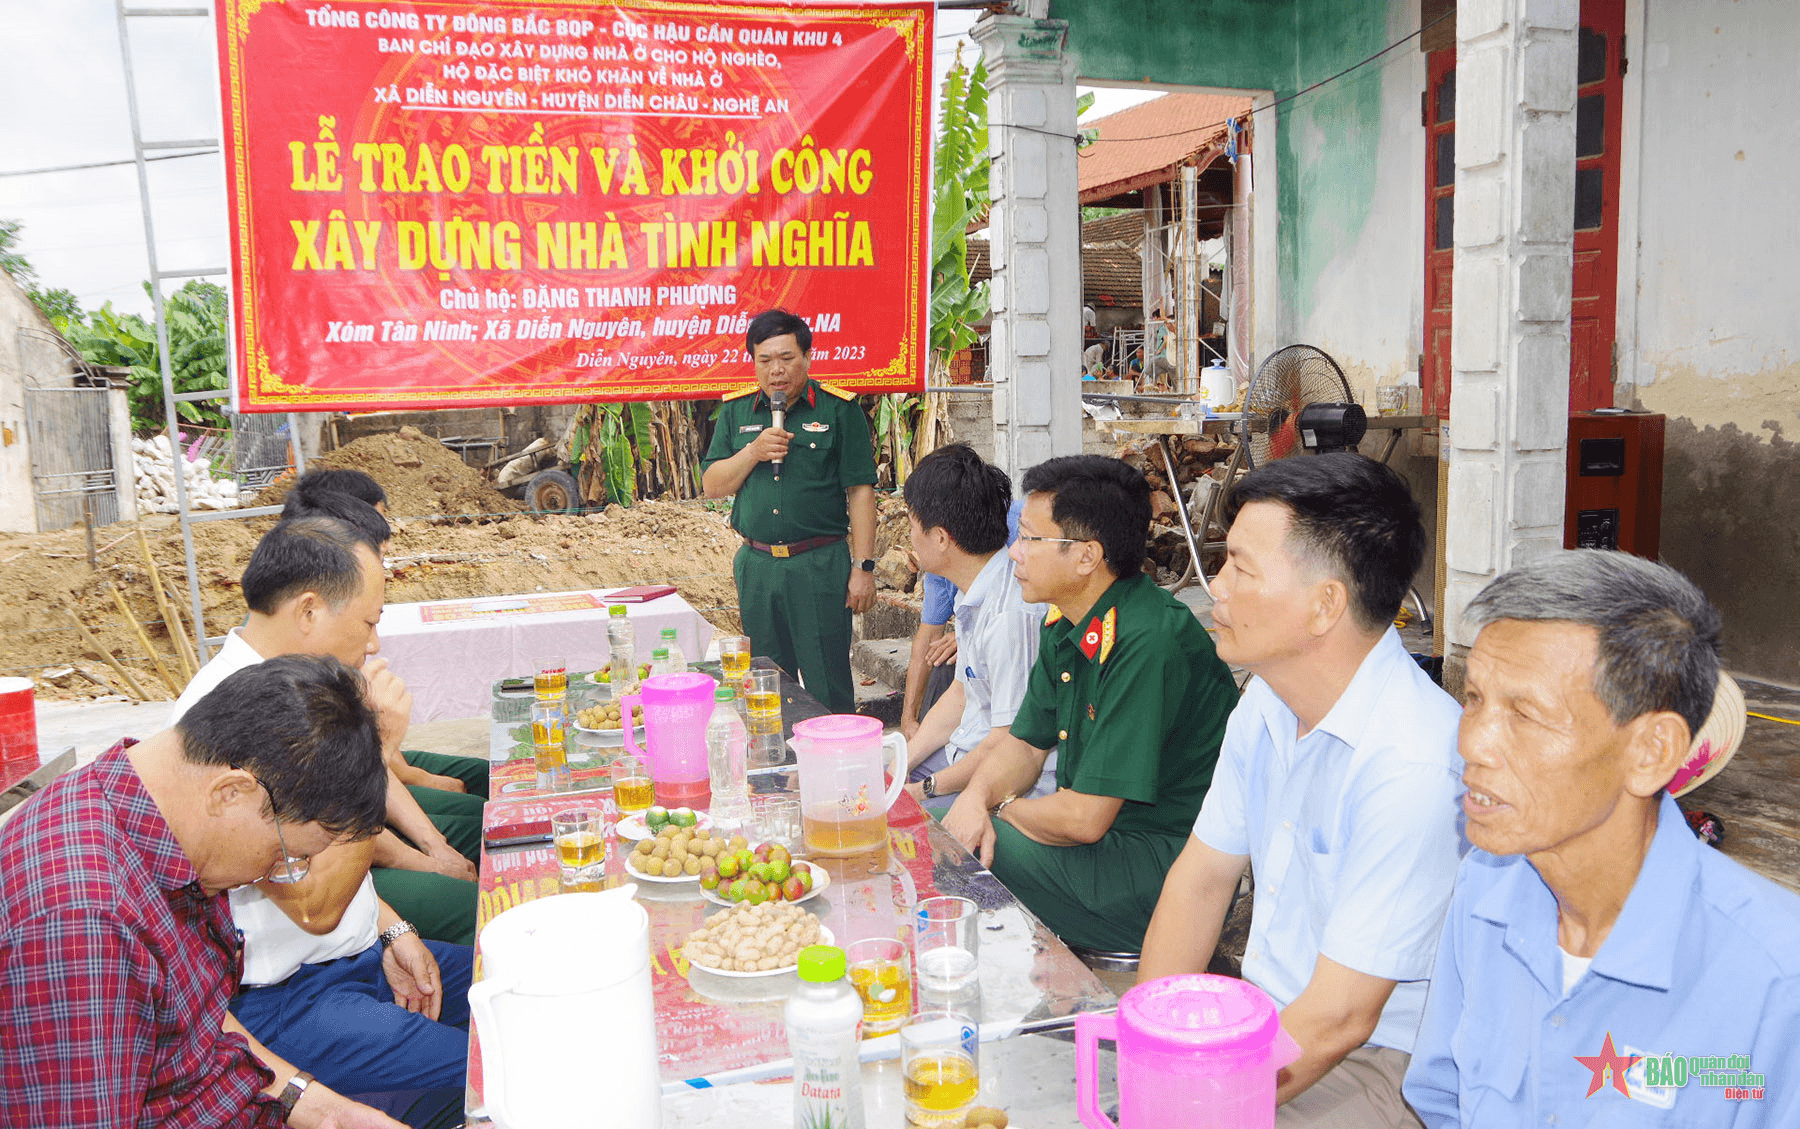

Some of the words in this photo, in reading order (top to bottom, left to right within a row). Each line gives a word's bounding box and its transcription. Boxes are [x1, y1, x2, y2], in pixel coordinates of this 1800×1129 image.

[305, 4, 360, 28] TỔNG
[365, 9, 420, 30] CÔNG
[424, 14, 447, 31] TY
[453, 13, 506, 34] ĐÔNG
[512, 14, 551, 36] BẮC
[557, 20, 593, 37] BQP
[612, 21, 648, 41] CỤC
[653, 23, 690, 43] HẬU
[738, 27, 787, 46] QUÂN
[792, 31, 827, 46] KHU
[832, 32, 843, 46] 4
[378, 38, 414, 53] BAN
[419, 36, 451, 55] CHỈ
[455, 41, 495, 60] ĐẠO
[500, 40, 534, 58] XÂY
[540, 44, 588, 62] DỰNG
[593, 43, 629, 61] NHÀ
[634, 43, 647, 61] Ở
[651, 48, 688, 64] CHO
[692, 48, 717, 68] HỘ
[722, 50, 781, 69] NGHÈO,
[443, 62, 470, 83] HỘ
[474, 63, 513, 84] ĐẶC
[518, 64, 550, 86] BIỆT
[556, 67, 592, 84] KHÓ
[597, 67, 643, 85] KHĂN
[648, 65, 666, 85] VỀ
[672, 71, 705, 87] NHÀ
[710, 72, 723, 88] Ở
[374, 84, 402, 103] XÃ
[406, 82, 448, 104] DIỄN
[453, 88, 526, 106] NGUYÊN
[542, 90, 599, 111] HUYỆN
[604, 88, 644, 109] DIỄN
[649, 93, 698, 111] CHÂU
[713, 95, 759, 116] NGHỆ
[765, 98, 789, 113] AN
[288, 115, 343, 191] LỄ
[352, 142, 471, 193] TRAO
[481, 121, 579, 194] TIỀN
[590, 133, 650, 195] VÀ
[660, 130, 760, 196] KHỞI
[771, 134, 873, 194] CÔNG
[290, 209, 382, 270] XÂY
[397, 216, 522, 281] DỰNG
[536, 211, 629, 270] NHÀ
[640, 212, 737, 269] TÌNH
[751, 211, 874, 267] NGHĨA
[440, 286, 479, 310] Chủ
[486, 288, 517, 313] hộ:
[523, 285, 579, 312] ĐẶNG
[585, 287, 651, 308] THANH
[657, 284, 737, 309] PHƯỢNG
[325, 320, 375, 343] Xóm
[381, 320, 419, 342] Tân
[423, 320, 479, 342] Ninh;
[483, 319, 511, 340] Xã
[516, 316, 563, 339] Diễn
[567, 317, 646, 340] Nguyên,
[652, 315, 711, 340] huyện
[576, 349, 612, 368] Diễn
[617, 351, 678, 370] Nguyên,
[682, 350, 717, 369] ngày
[722, 349, 738, 363] 22
[811, 347, 829, 361] ăm
[833, 346, 865, 361] 2023
